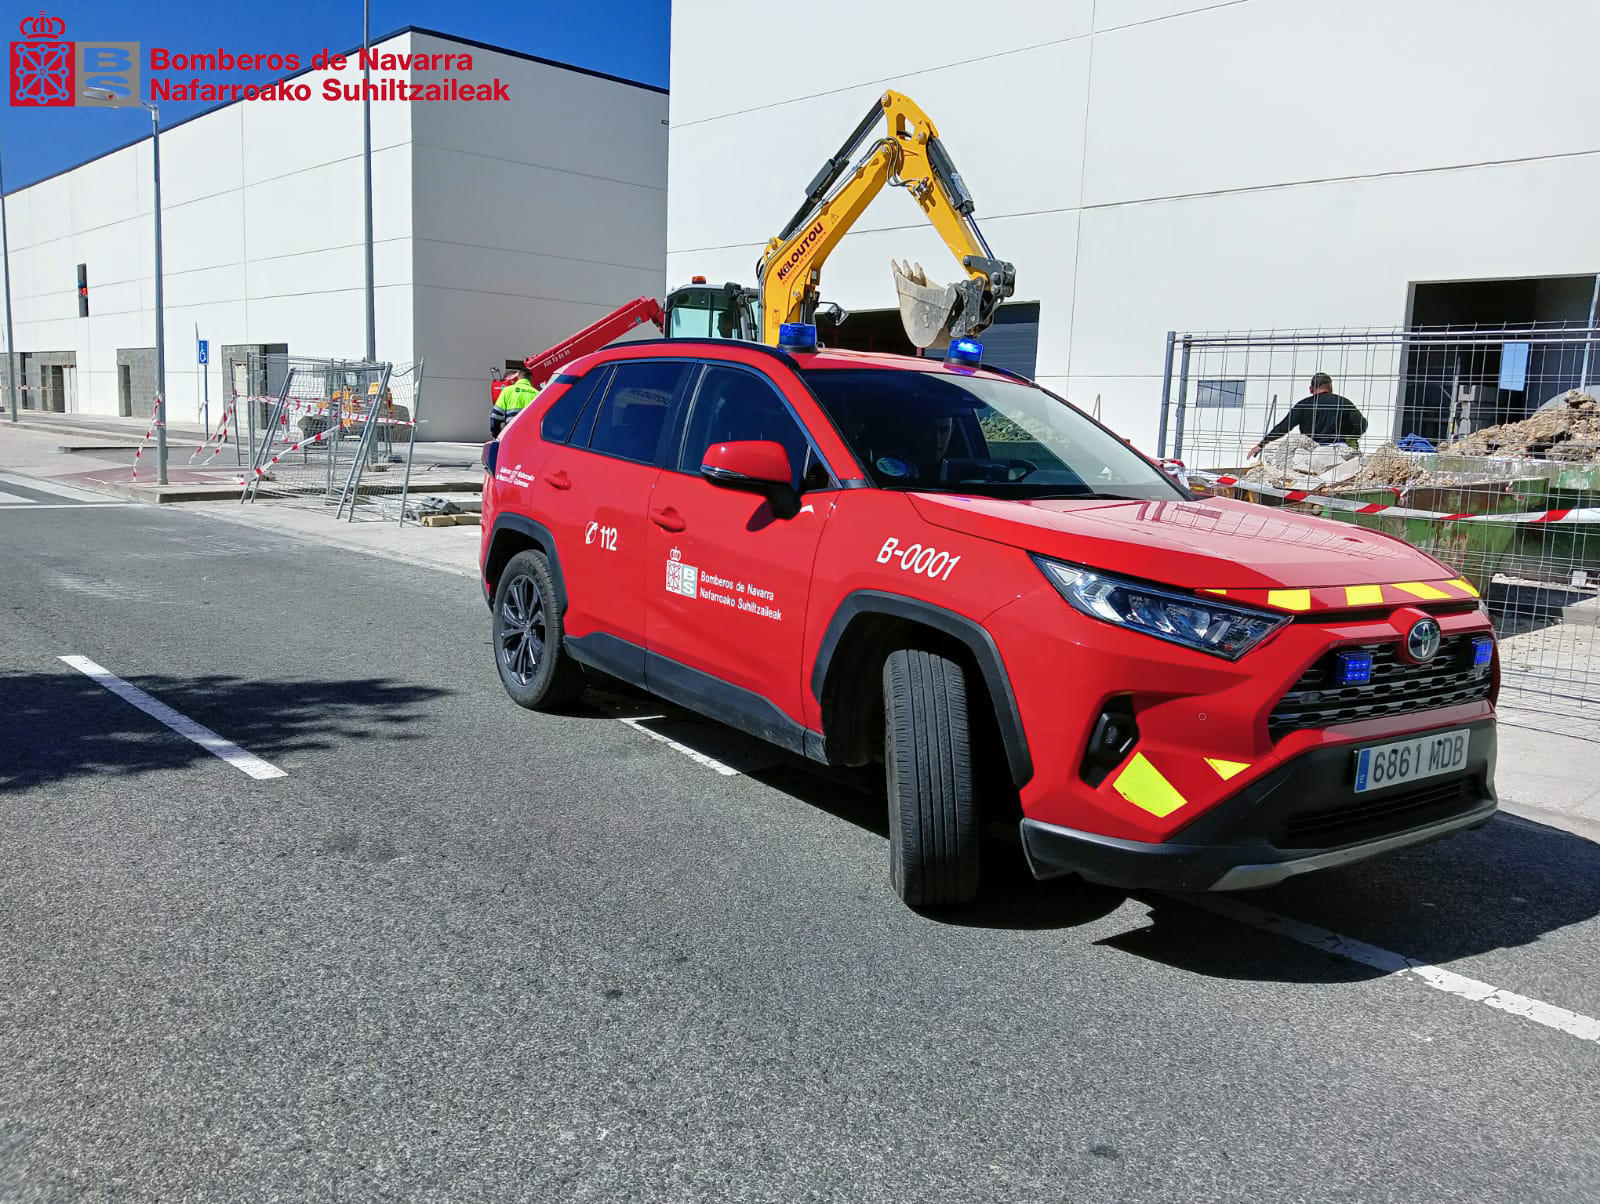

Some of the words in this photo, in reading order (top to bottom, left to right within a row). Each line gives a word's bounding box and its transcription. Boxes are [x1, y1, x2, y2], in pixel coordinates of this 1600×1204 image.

[600, 525, 617, 551] 112
[876, 536, 961, 581] B-0001
[700, 586, 736, 608] Nafarroako
[737, 597, 782, 621] Suhiltzaileak
[701, 571, 733, 590] Bomberos
[736, 580, 745, 592] de
[747, 583, 774, 601] Navarra
[1373, 743, 1422, 783] 6861
[1428, 735, 1464, 772] MDB
